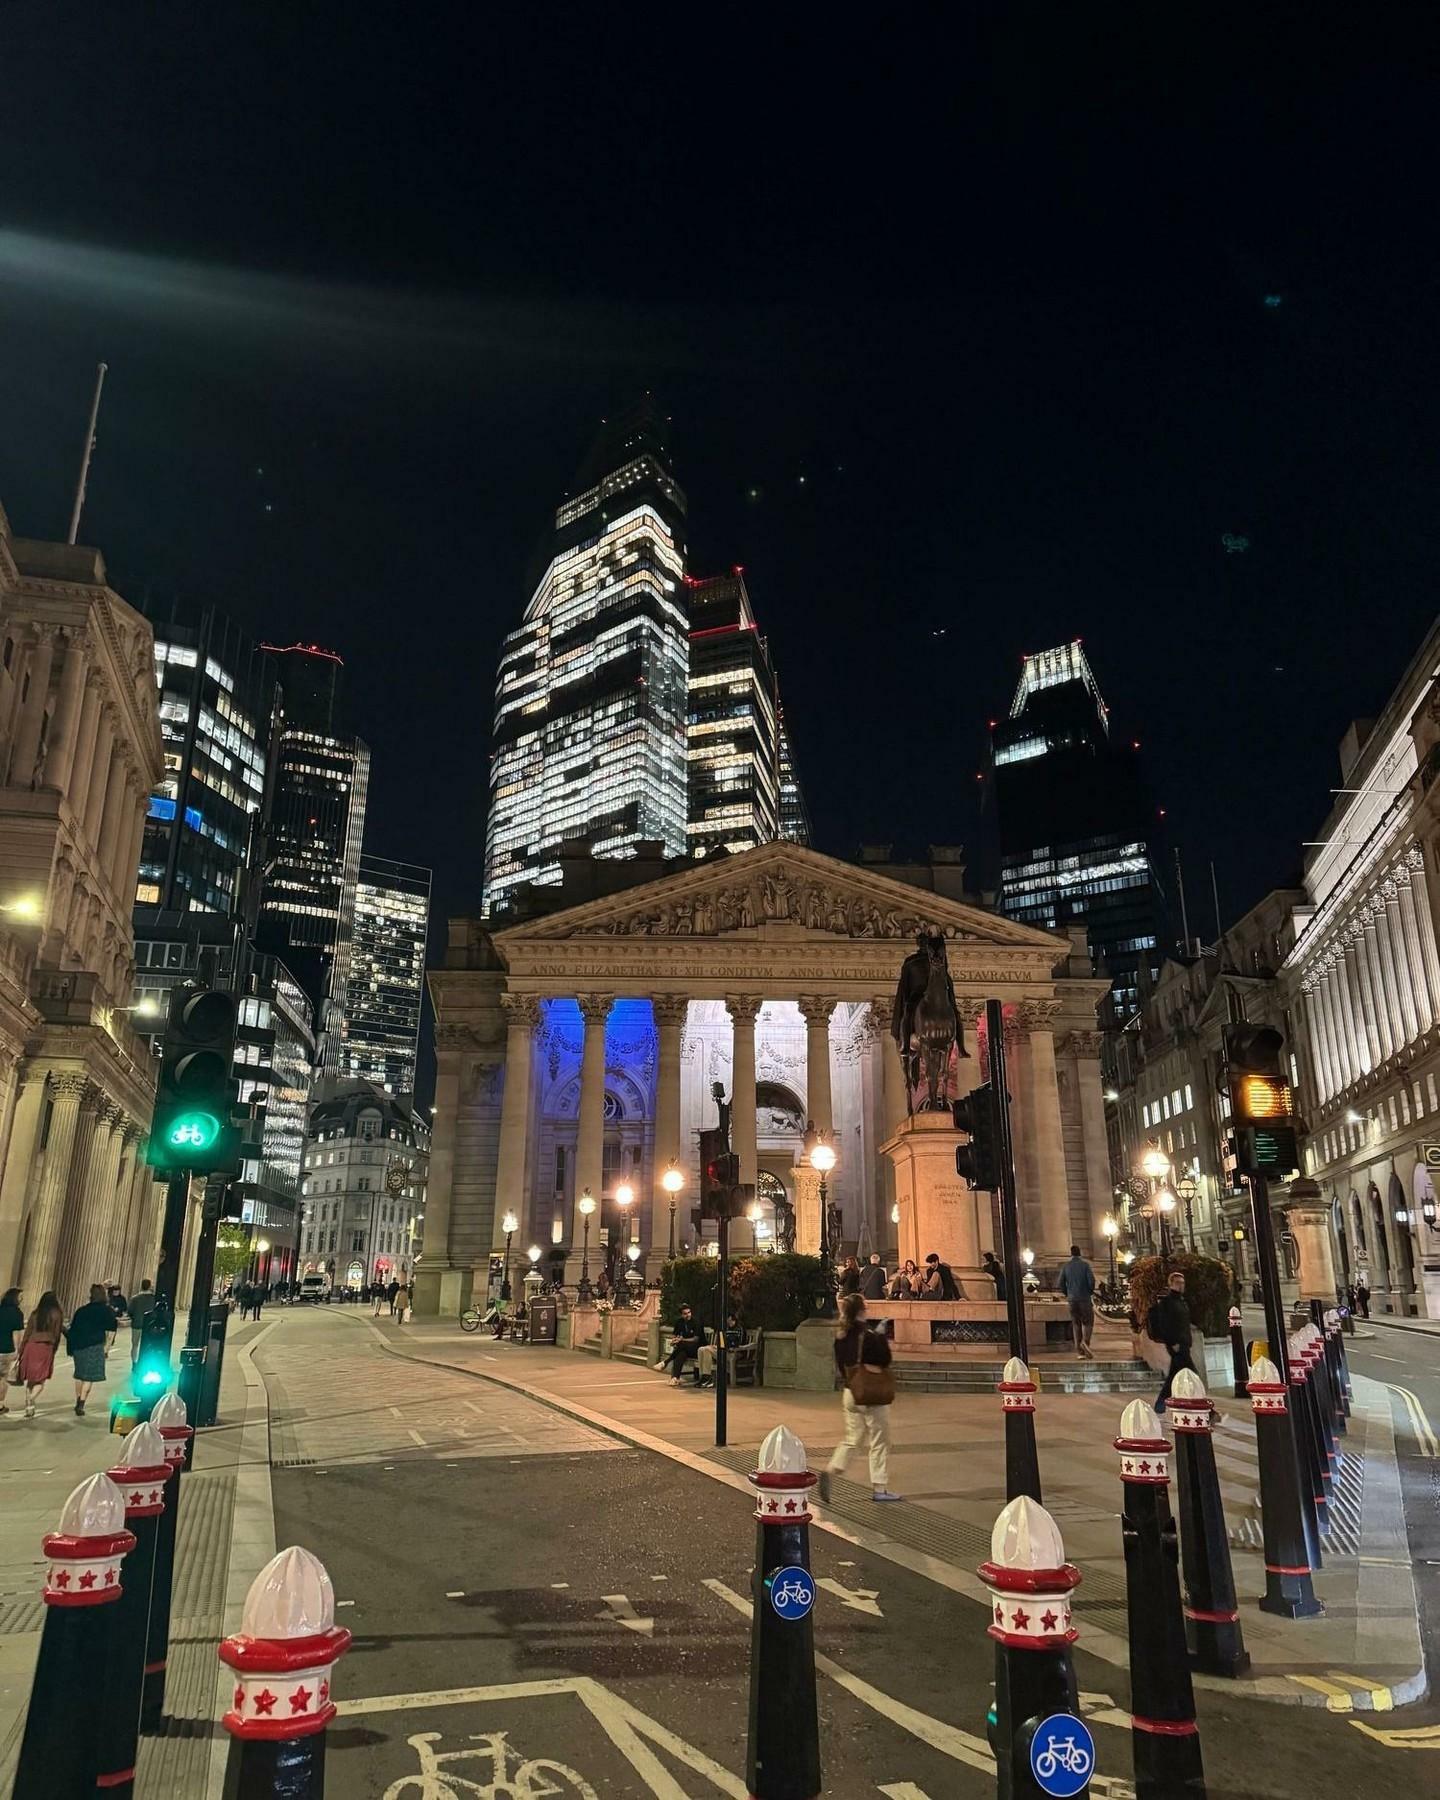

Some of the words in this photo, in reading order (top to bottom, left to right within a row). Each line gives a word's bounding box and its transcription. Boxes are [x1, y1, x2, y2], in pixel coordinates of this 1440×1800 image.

[530, 964, 567, 975] ANNO
[575, 964, 662, 976] ELIZABETHAE
[685, 966, 704, 977] XIII
[710, 966, 774, 978] CONDITVM
[788, 967, 824, 978] ANNO
[832, 967, 897, 979] VICTORIAE
[950, 969, 1034, 982] ESTAVRATVM
